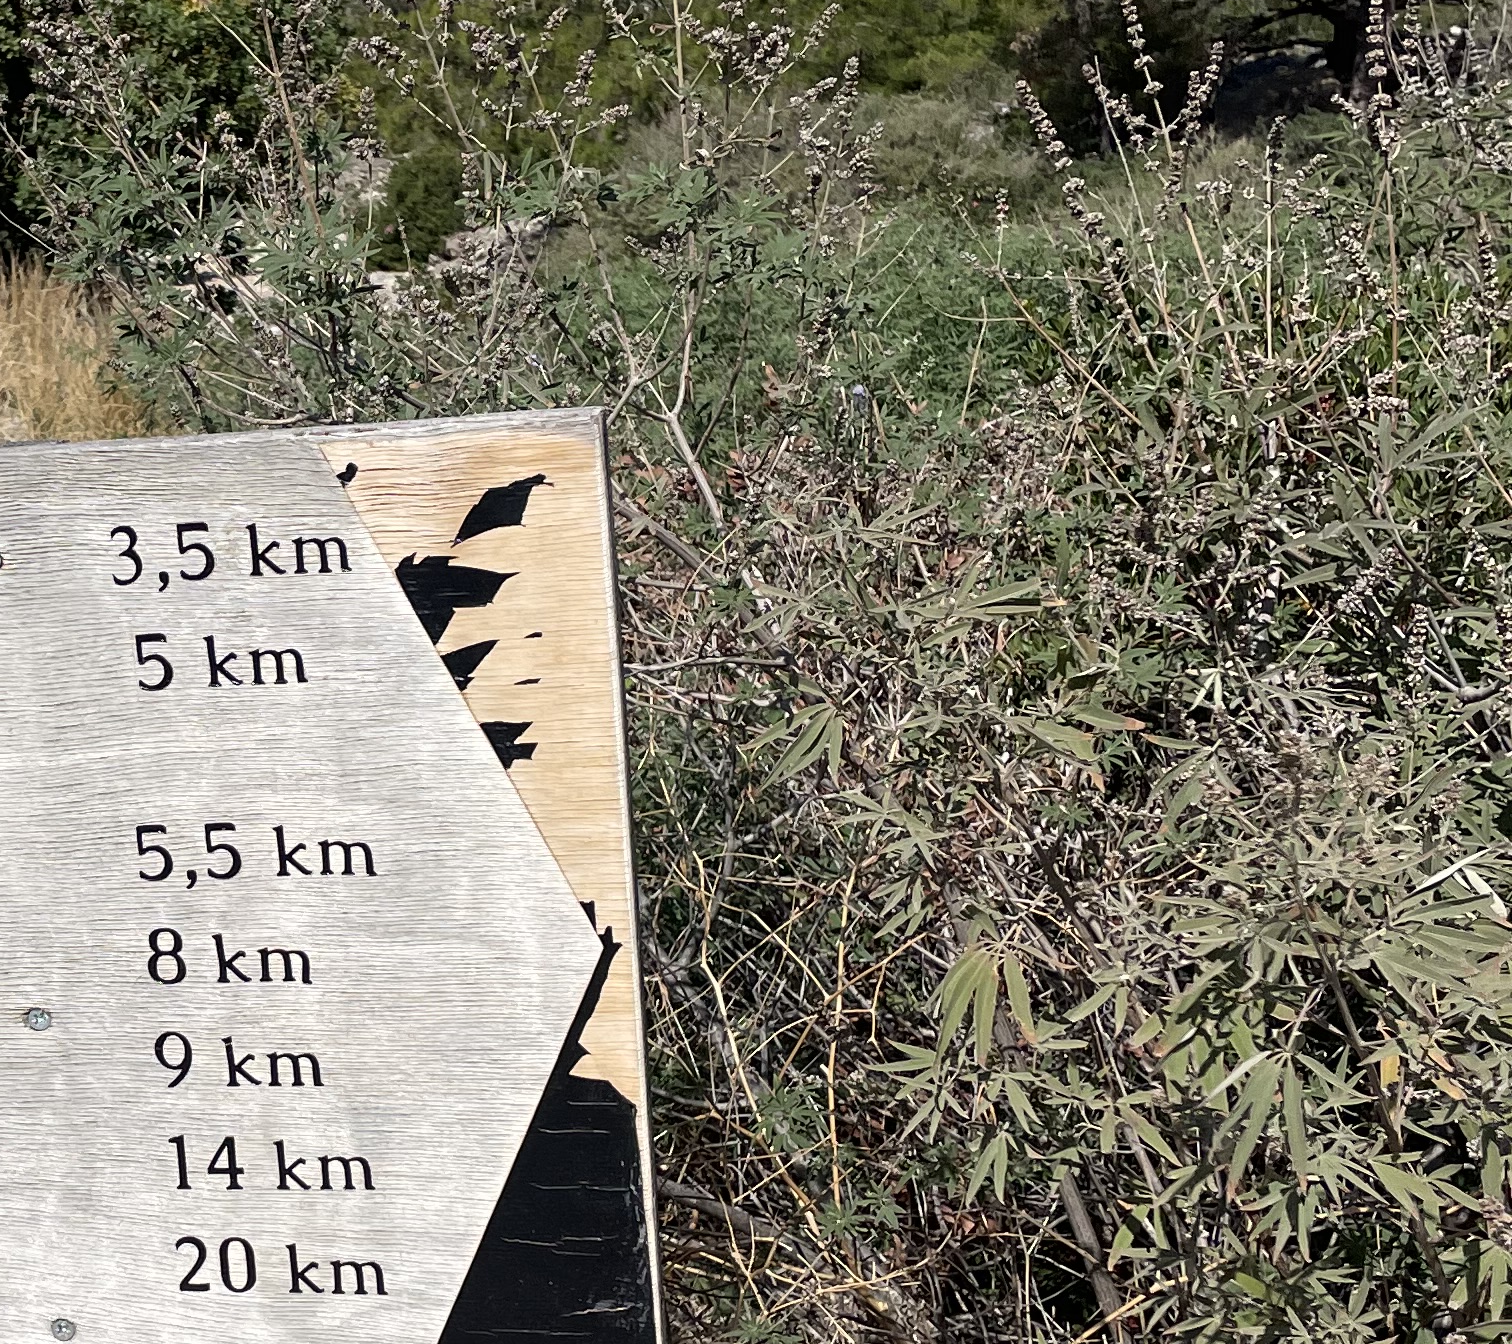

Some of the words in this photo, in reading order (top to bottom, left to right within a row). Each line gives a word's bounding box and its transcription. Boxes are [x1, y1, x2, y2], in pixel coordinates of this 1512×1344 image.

[110, 521, 215, 593] 3,5
[245, 522, 352, 577] km
[135, 632, 174, 692] 5
[202, 634, 309, 688] km
[135, 822, 242, 890] 5,5
[272, 824, 378, 877] km
[147, 927, 187, 985] 8
[211, 933, 313, 985] km
[154, 1031, 193, 1088] 9
[221, 1035, 325, 1087] km
[168, 1134, 245, 1191] 14
[272, 1139, 376, 1191] km
[175, 1236, 257, 1293] 20
[285, 1243, 389, 1296] km
